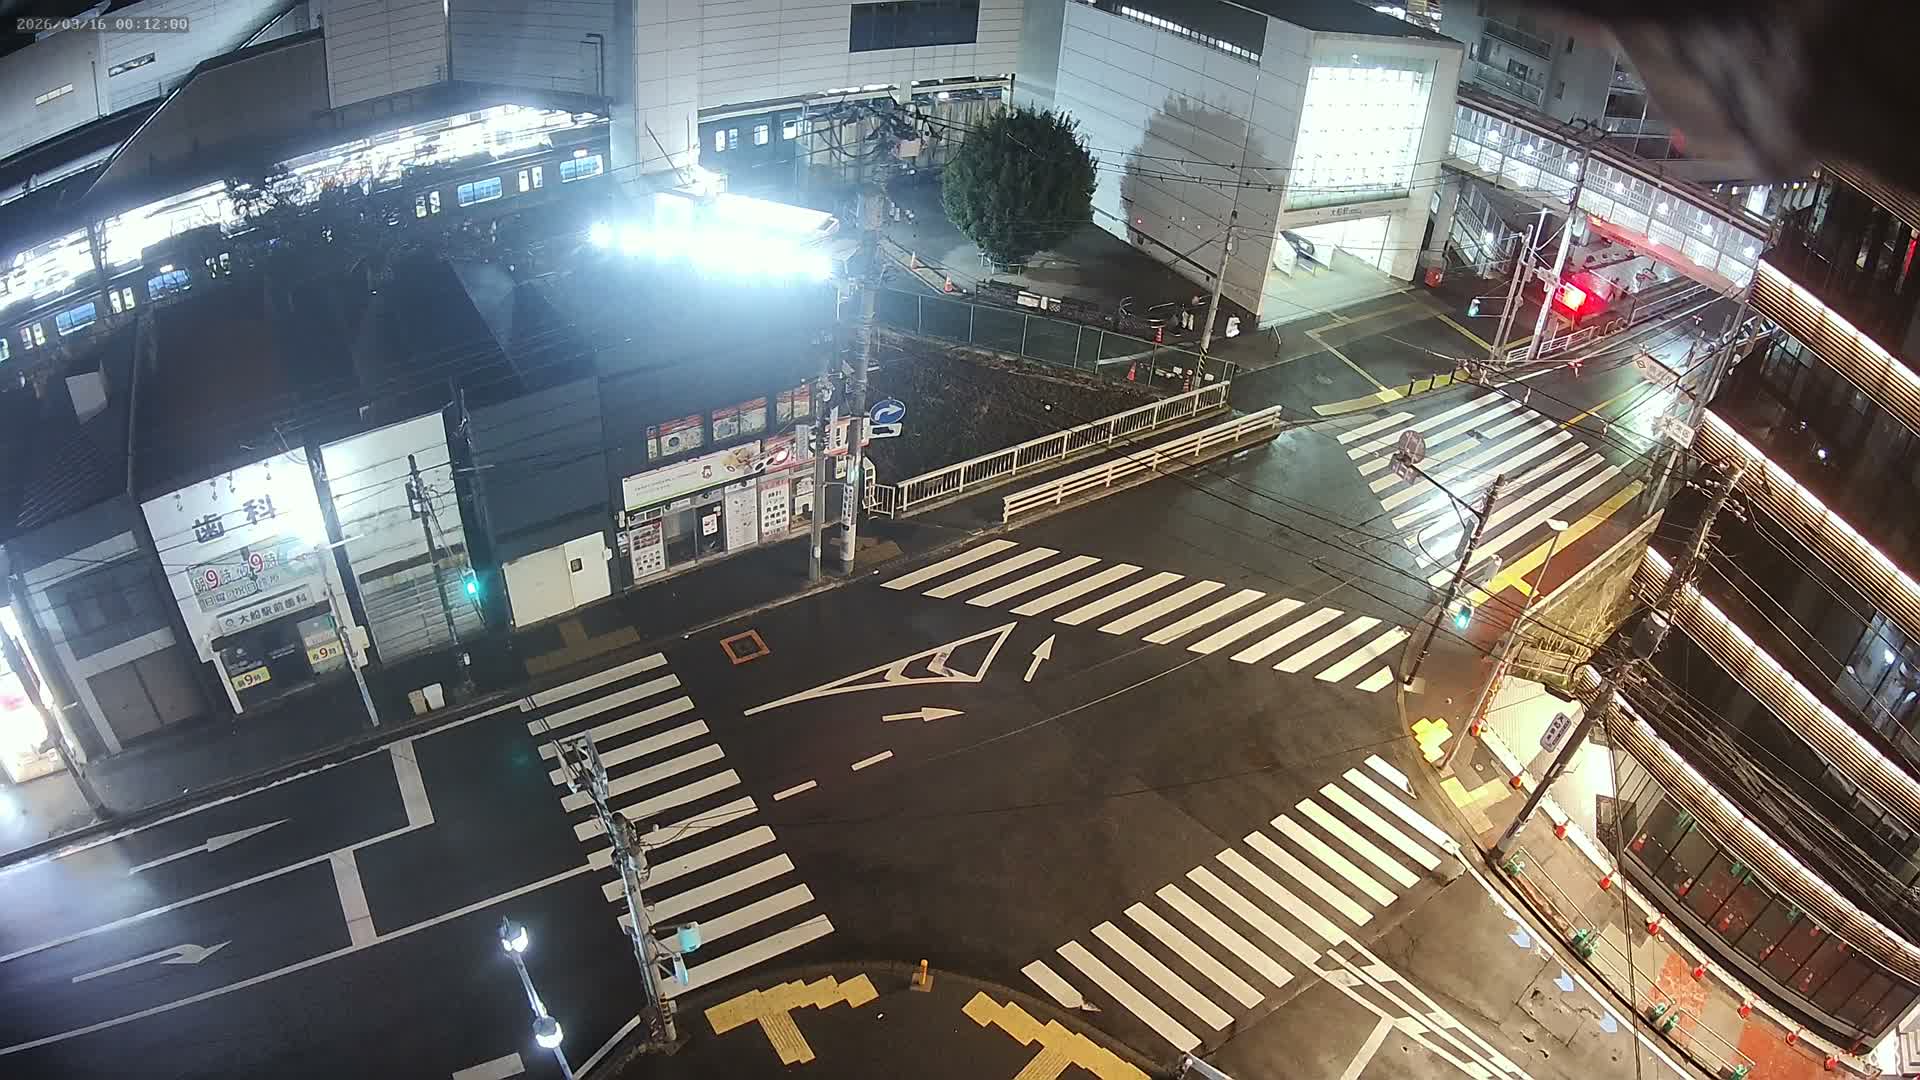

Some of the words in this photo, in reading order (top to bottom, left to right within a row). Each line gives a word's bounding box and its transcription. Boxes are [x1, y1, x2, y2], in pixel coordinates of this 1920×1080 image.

[192, 494, 276, 543] 歯科
[240, 593, 307, 625] 大船駅前歯科
